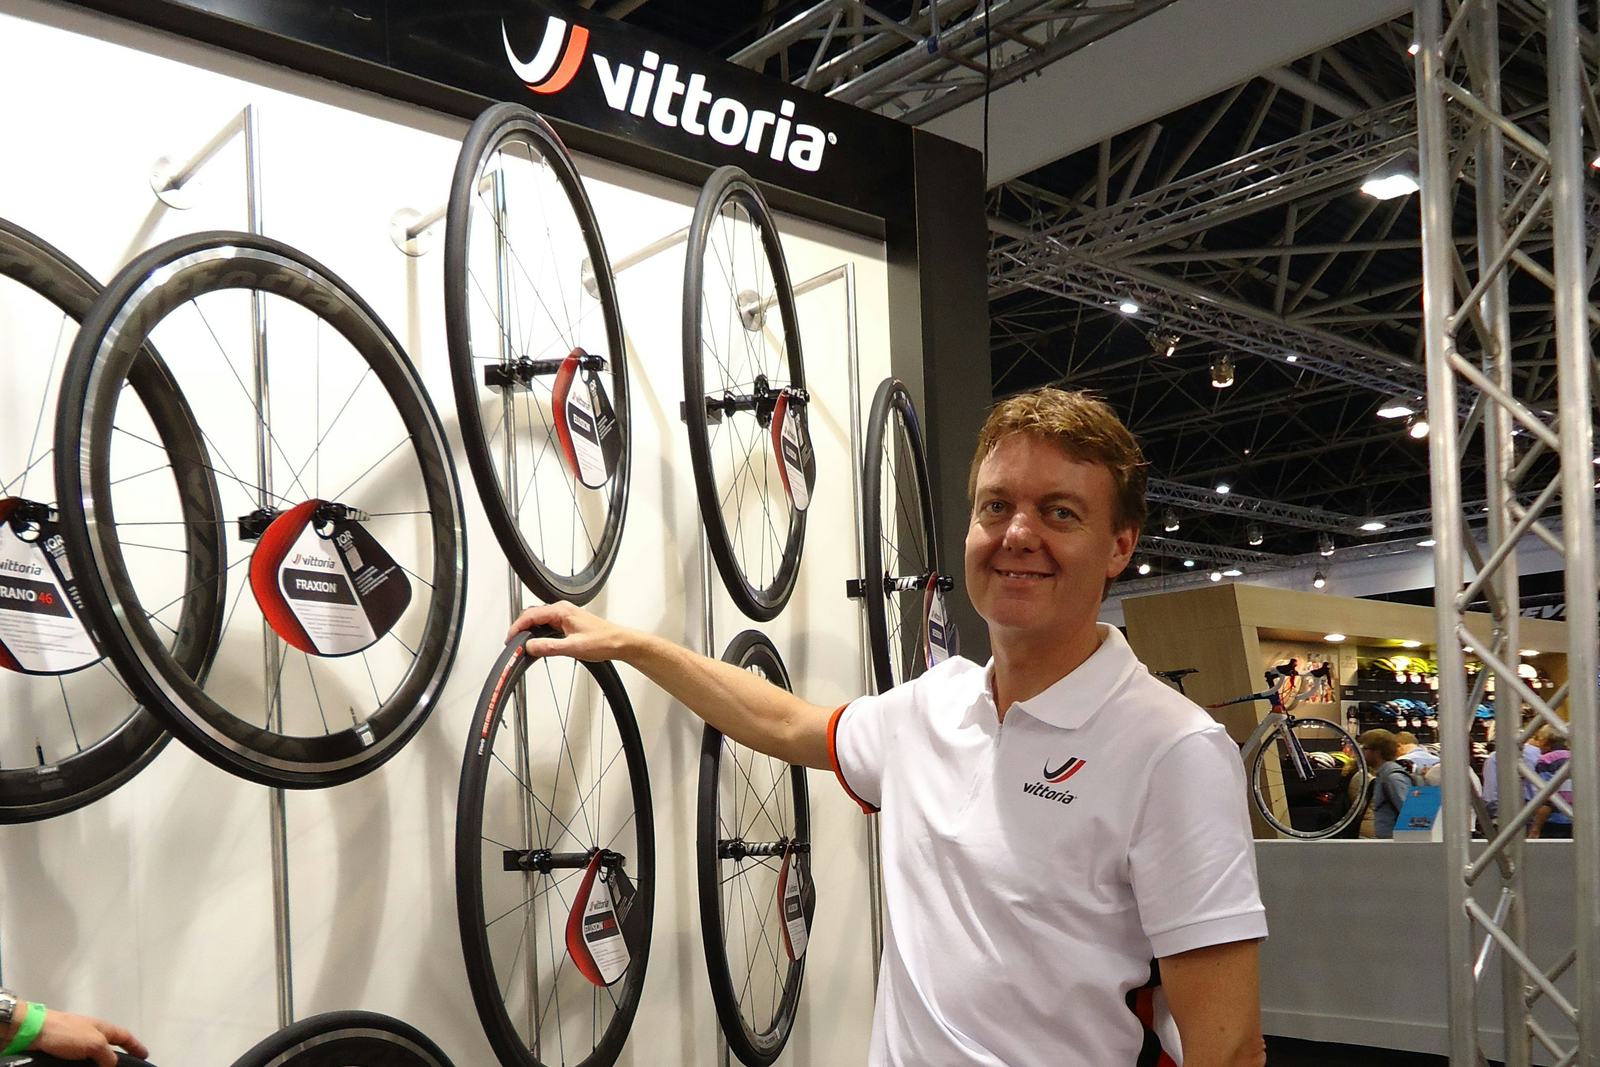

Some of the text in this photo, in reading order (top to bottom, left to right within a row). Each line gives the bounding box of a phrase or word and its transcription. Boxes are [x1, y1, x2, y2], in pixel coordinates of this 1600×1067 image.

[302, 555, 335, 569] vittoria
[295, 578, 338, 593] FRAXION
[1022, 781, 1075, 805] vittoria
